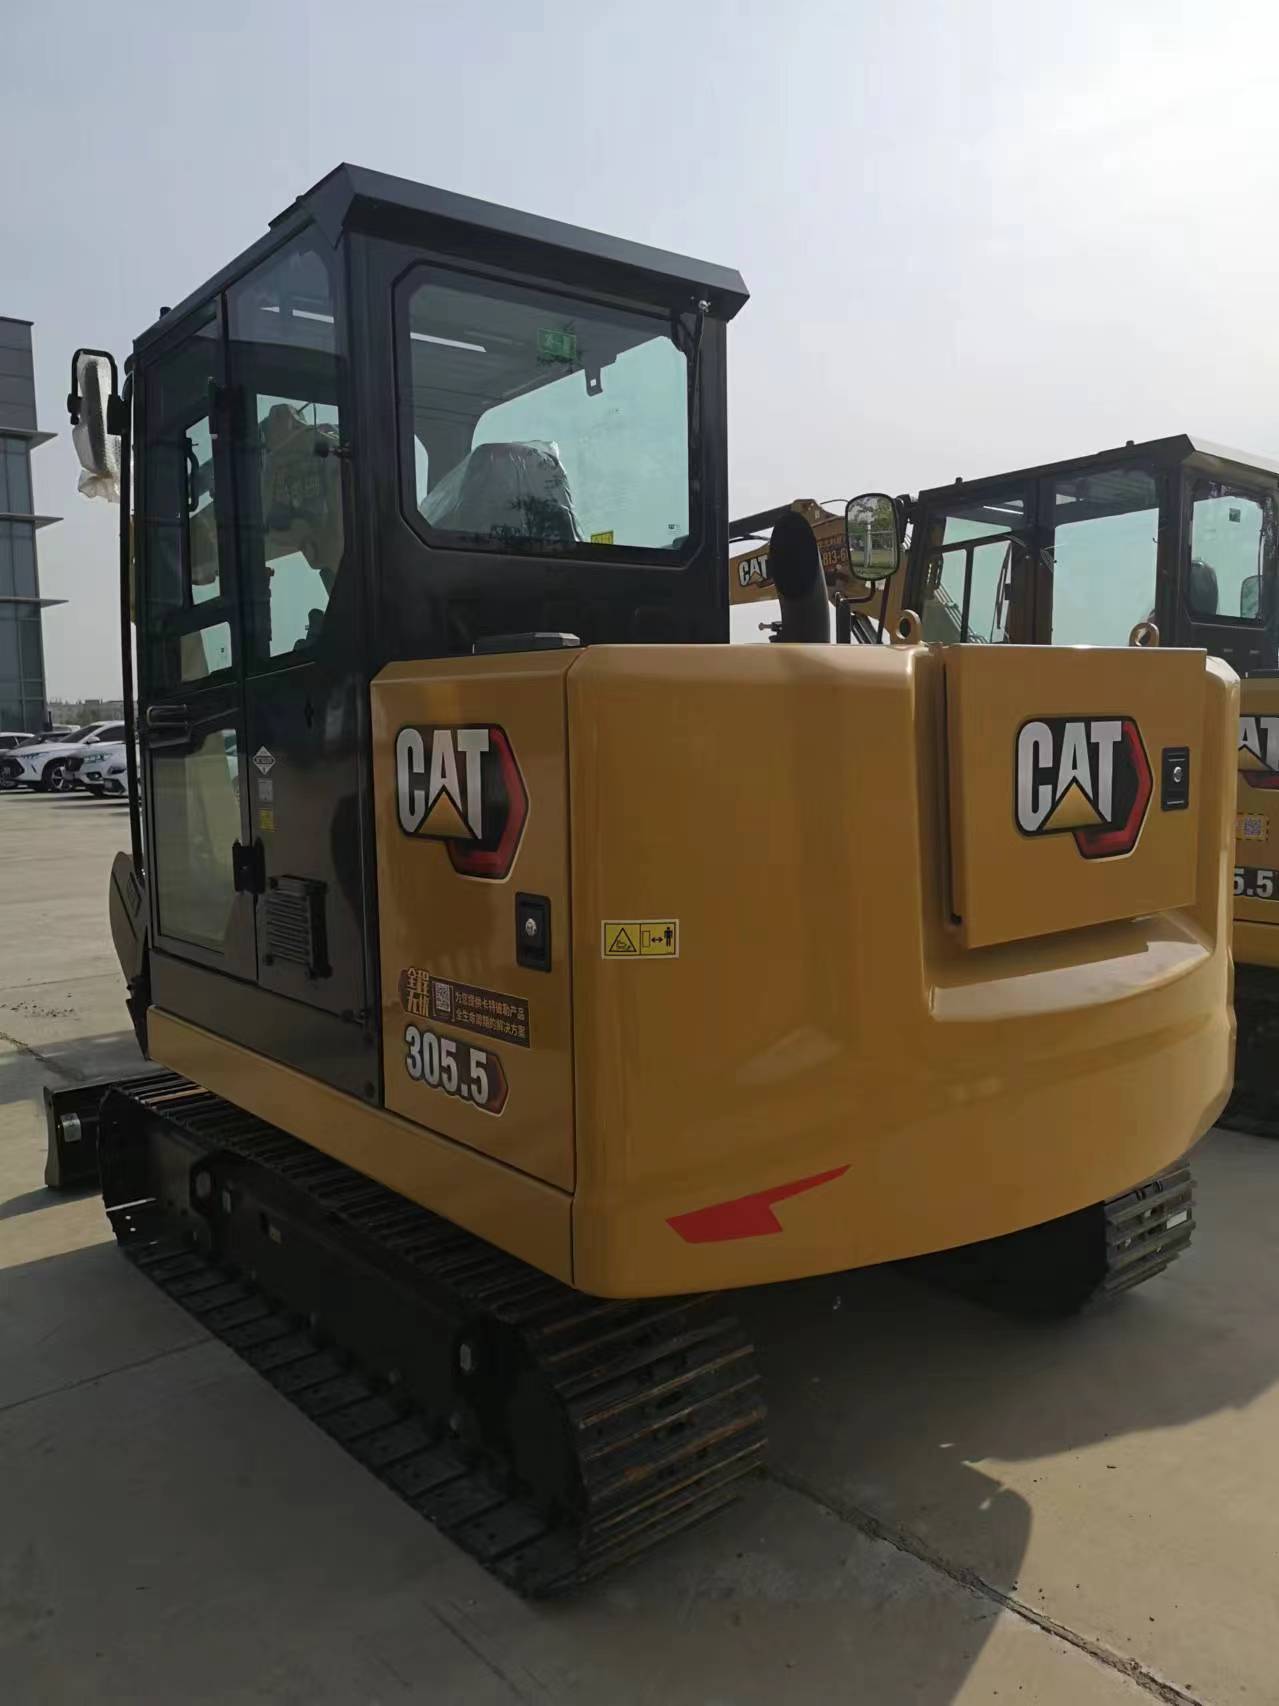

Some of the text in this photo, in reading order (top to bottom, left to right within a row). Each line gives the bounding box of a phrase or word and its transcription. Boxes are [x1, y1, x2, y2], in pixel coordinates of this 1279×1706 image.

[738, 554, 769, 586] CAT
[396, 727, 490, 840] CAT
[1017, 720, 1122, 832] CAT
[407, 967, 430, 993] 全程
[405, 1026, 489, 1105] 305.5
